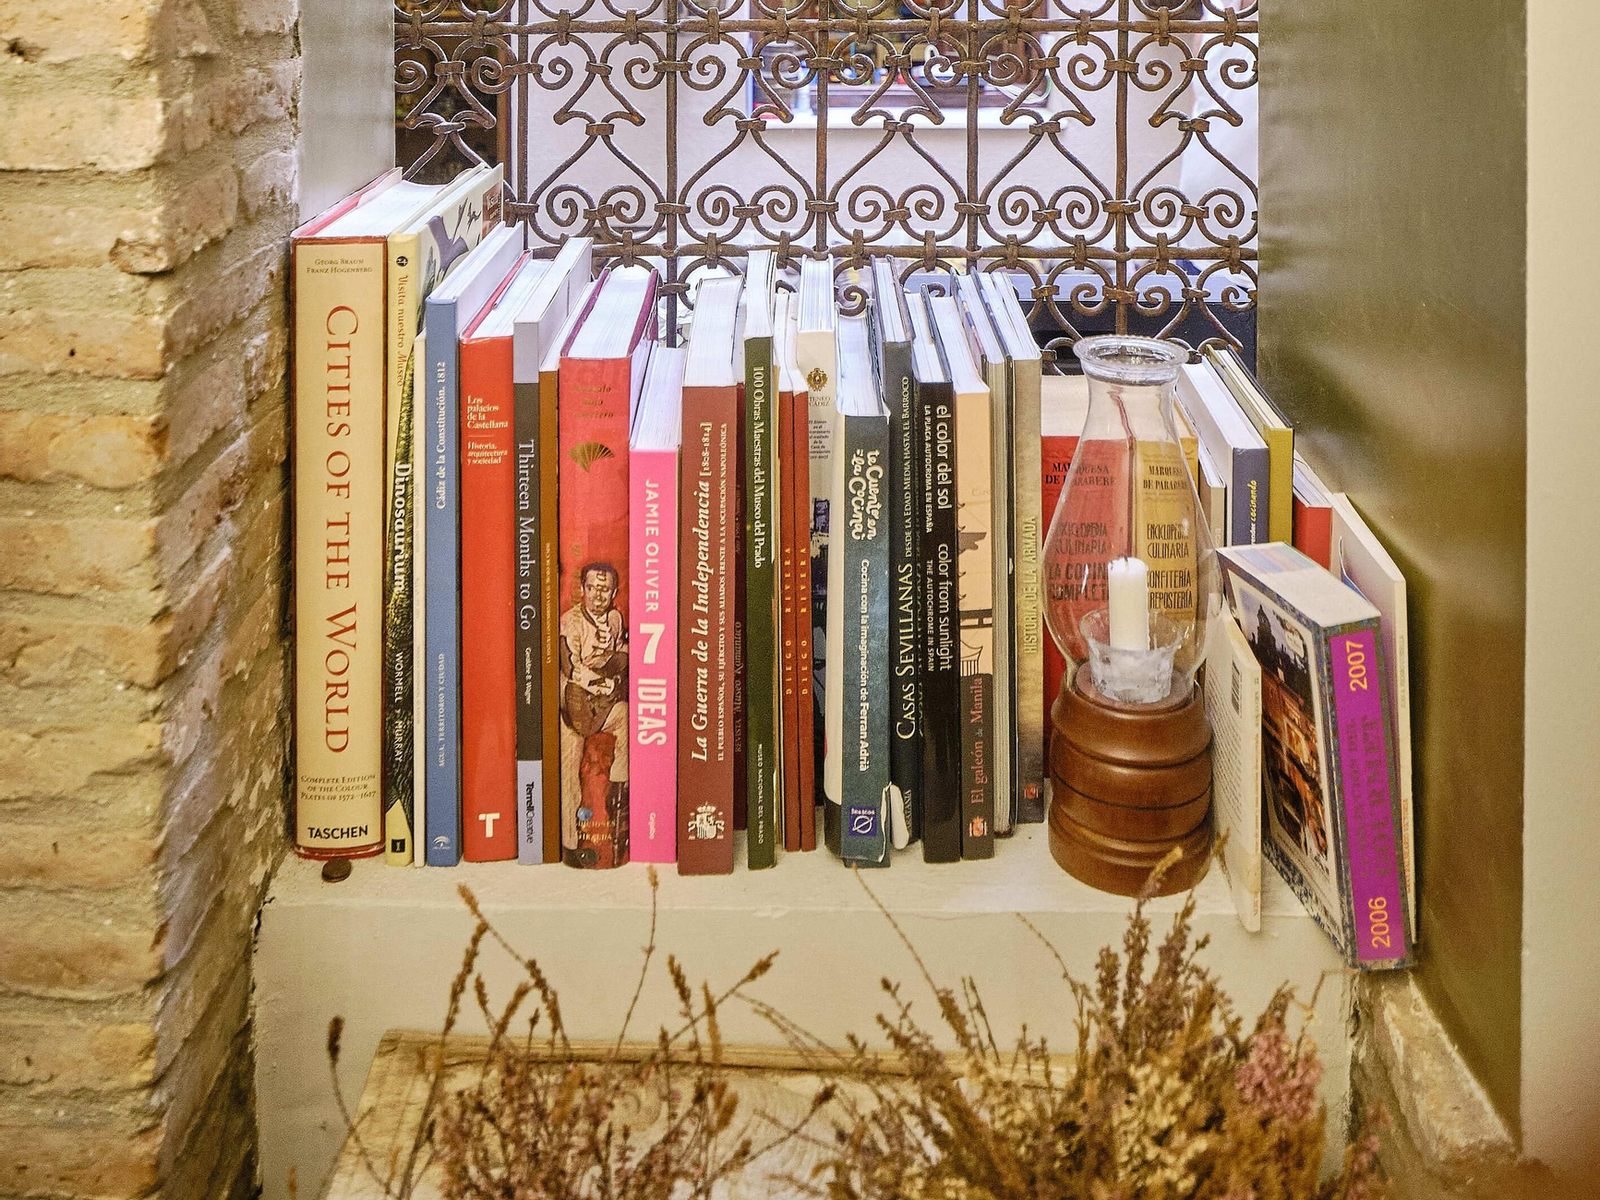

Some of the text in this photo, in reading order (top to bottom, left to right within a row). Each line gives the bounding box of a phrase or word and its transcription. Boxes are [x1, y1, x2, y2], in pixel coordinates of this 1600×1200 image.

[396, 275, 409, 388] Visita nuestro Museo
[466, 395, 483, 404] Los
[466, 412, 486, 421] de la
[467, 404, 499, 413] palacios
[435, 361, 447, 510] Cádiz de la Constitución. 1812
[466, 420, 509, 429] Castellana
[467, 455, 502, 466] y sociedad
[468, 450, 508, 458] arquitectura
[719, 423, 728, 478] NAPOLEÓNICA
[753, 366, 766, 569] 100 Obras Maestras del Museo del Prado
[1045, 475, 1061, 485] DE
[1143, 479, 1153, 489] DE
[718, 479, 727, 525] OCUPACIÓN
[1246, 480, 1258, 522] cocinando
[325, 305, 359, 753] CITIES OF THE WORLD
[393, 461, 413, 594] Dinosaurium
[518, 439, 536, 630] Thirteen Months to Go
[719, 526, 726, 537] LA
[924, 404, 935, 672] LA PLACA AUTOCROMA EN ESPAÑA THE AUTOCHROME IN SPAIN
[936, 404, 953, 671] el color del sol color from sunlight
[645, 480, 660, 613] JAMIE OLIVER
[691, 480, 714, 614] Independencia
[894, 376, 916, 740] CASAS SEVILLANAS DESDE LA EDAD MEDIA HASTA EL BARROCO
[1147, 542, 1190, 559] CULINARIA
[861, 558, 870, 593] Cocina
[1022, 515, 1038, 655] HISTORIA DE LA ARMADA
[1065, 563, 1109, 580] COCIN
[718, 576, 726, 609] ALIADOS
[861, 594, 869, 613] con
[1051, 584, 1109, 602] COMPLET
[691, 618, 708, 636] la
[718, 610, 726, 625] SUS
[784, 547, 793, 695] DIEGO RIVERA
[799, 547, 809, 695] DIEGO RIVERA
[860, 615, 870, 625] la
[639, 623, 666, 664] 7
[691, 640, 708, 663] de
[717, 633, 726, 669] EJÉRCITO
[858, 625, 870, 687] imaginación
[437, 652, 446, 685] CIUDAD
[717, 670, 726, 682] SU
[637, 678, 667, 746] IDEAS
[691, 667, 708, 731] Guerra
[716, 682, 726, 719] ESPAÑOL,
[860, 688, 870, 701] de
[969, 677, 984, 724] Manila
[437, 692, 446, 742] TERRITORIO
[717, 720, 725, 749] PUEBLO
[860, 702, 870, 739] Ferran
[691, 736, 708, 762] La
[717, 750, 725, 762] EL
[969, 740, 988, 785] galeón
[970, 788, 984, 804] El
[1345, 639, 1392, 949] 2006 2007
[307, 825, 368, 840] TASCHEN
